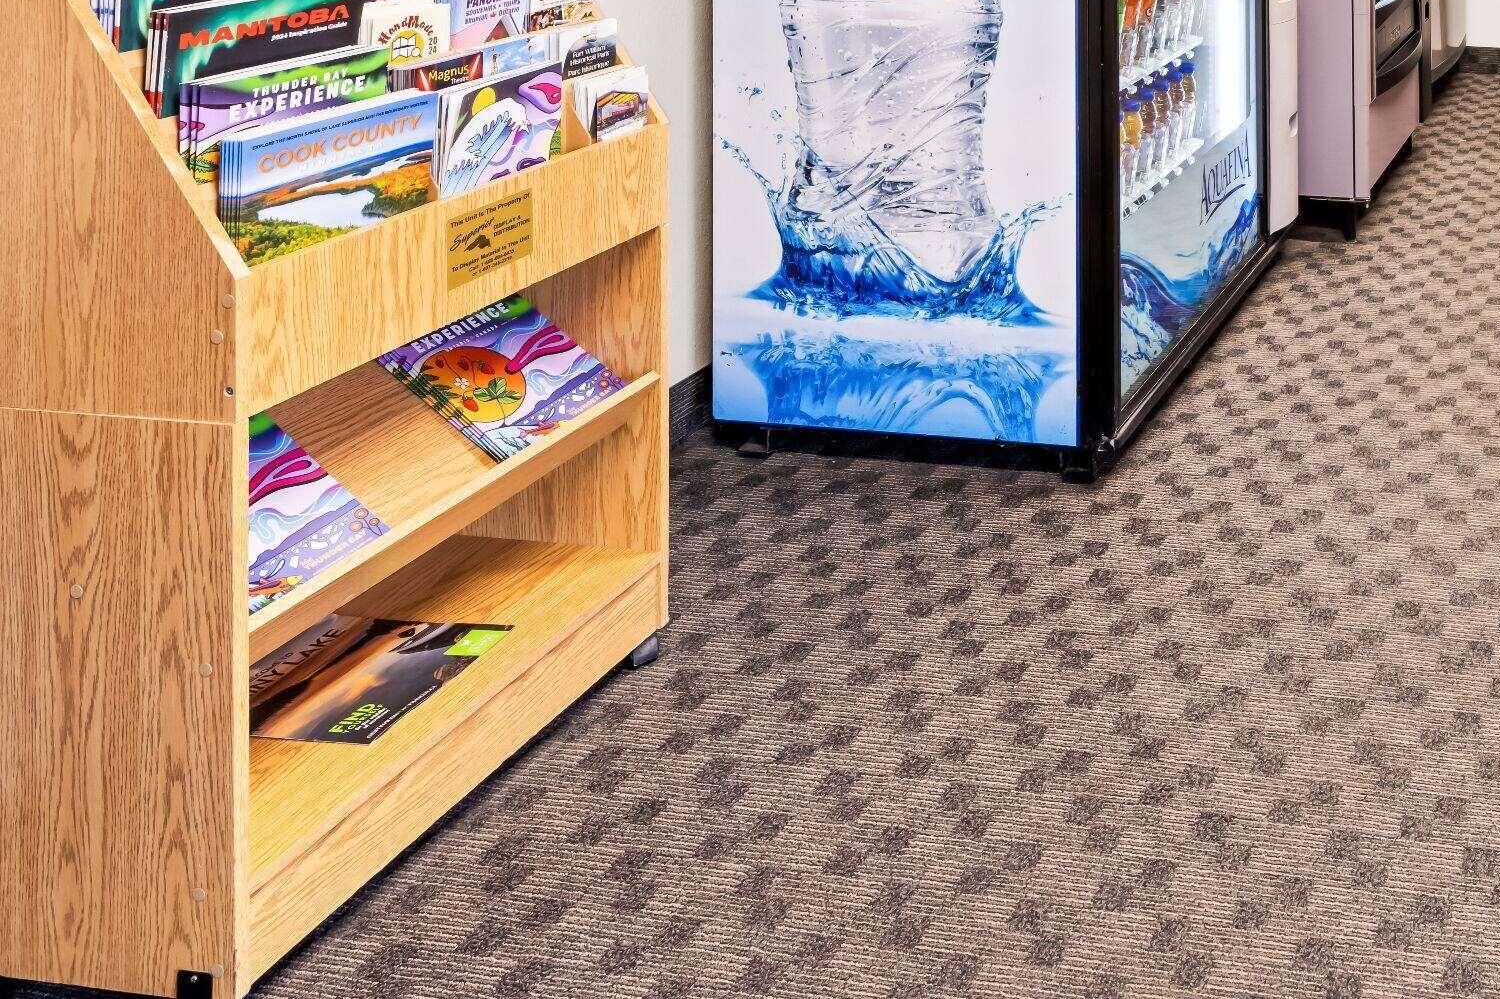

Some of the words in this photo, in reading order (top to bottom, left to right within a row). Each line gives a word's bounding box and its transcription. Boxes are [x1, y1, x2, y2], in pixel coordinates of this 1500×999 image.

[179, 1, 350, 50] MANITOBA
[288, 25, 327, 39] Inspiration
[327, 21, 348, 31] Guide
[429, 36, 438, 46] 20
[252, 74, 318, 98] THUNDER
[323, 68, 349, 81] BAY
[428, 64, 470, 83] Magnus
[229, 75, 366, 123] EXPERIENCE
[257, 138, 327, 175] COOK
[332, 112, 424, 153] COUNTY
[1199, 127, 1251, 225] AQUAFINA
[450, 220, 464, 229] This
[465, 213, 478, 222] Unit
[486, 206, 497, 215] The
[497, 197, 522, 210] Property
[411, 302, 510, 353] EXPERIENCE
[282, 628, 347, 666] LAKE
[328, 703, 377, 734] FIND
